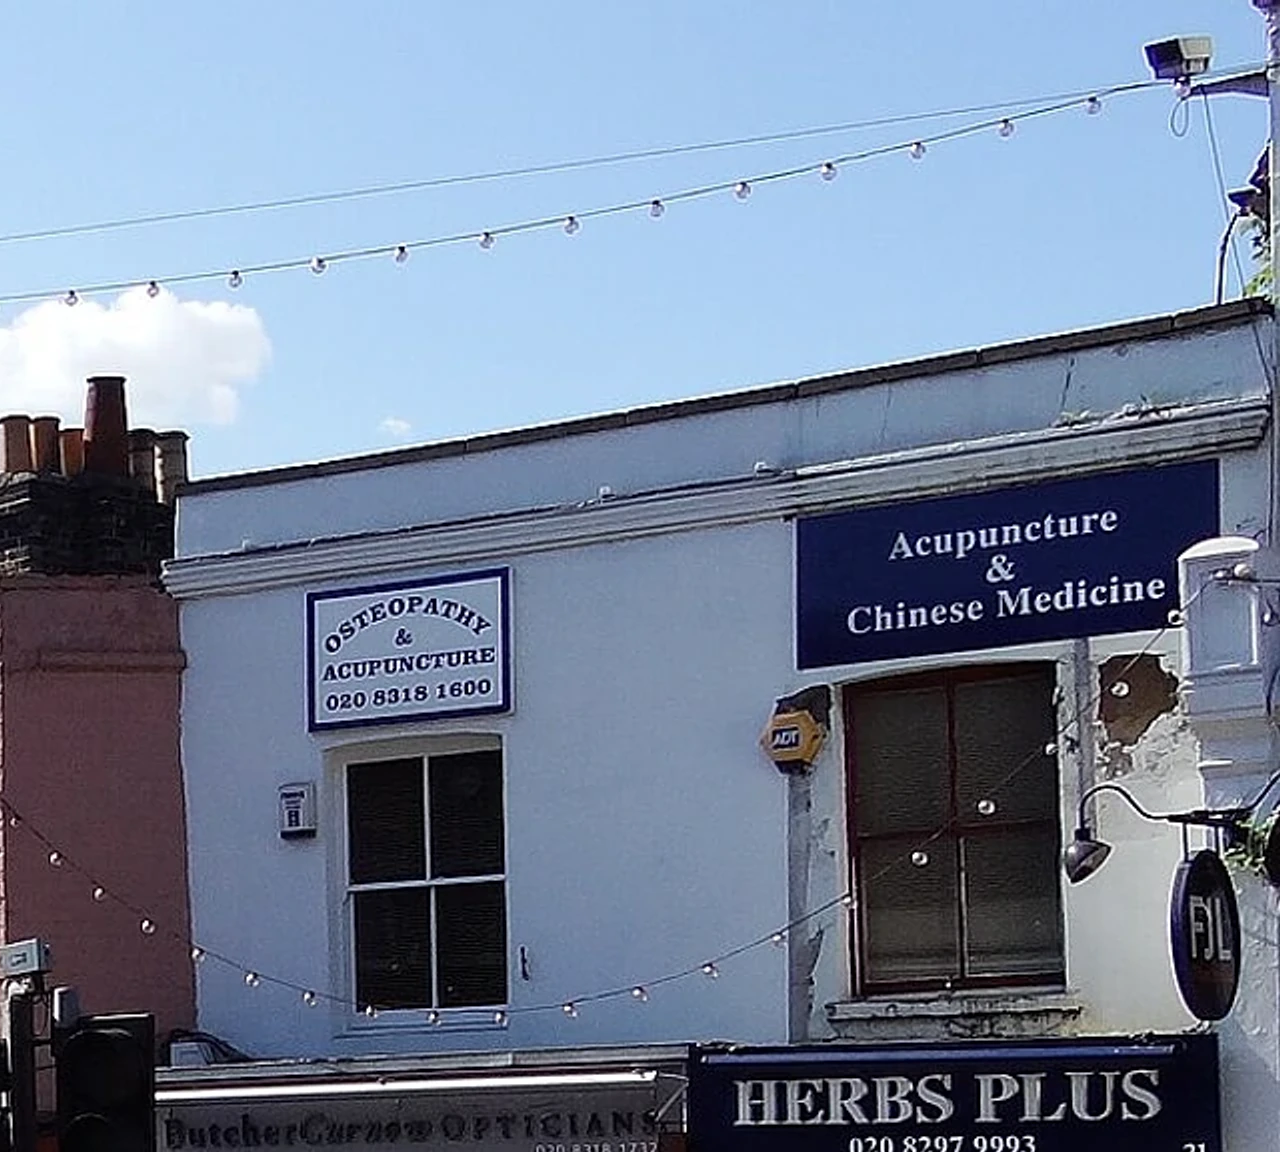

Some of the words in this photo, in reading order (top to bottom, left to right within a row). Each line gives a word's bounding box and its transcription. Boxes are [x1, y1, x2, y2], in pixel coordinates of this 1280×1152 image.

[888, 507, 1119, 561] Acupuncture
[985, 554, 1016, 584] &
[846, 596, 984, 635] Chinese
[996, 575, 1166, 618] Medicine
[324, 596, 492, 653] OSTEOPATHY
[394, 628, 413, 646] &
[322, 647, 496, 682] ACUPUNCTURE
[326, 691, 367, 711] 020
[372, 686, 428, 707] 8318
[436, 679, 492, 700] 1600
[773, 730, 799, 746] ADT
[733, 1073, 953, 1127] HERBS
[973, 1068, 1163, 1124] PLUS
[440, 1107, 656, 1142] OPTICIANS
